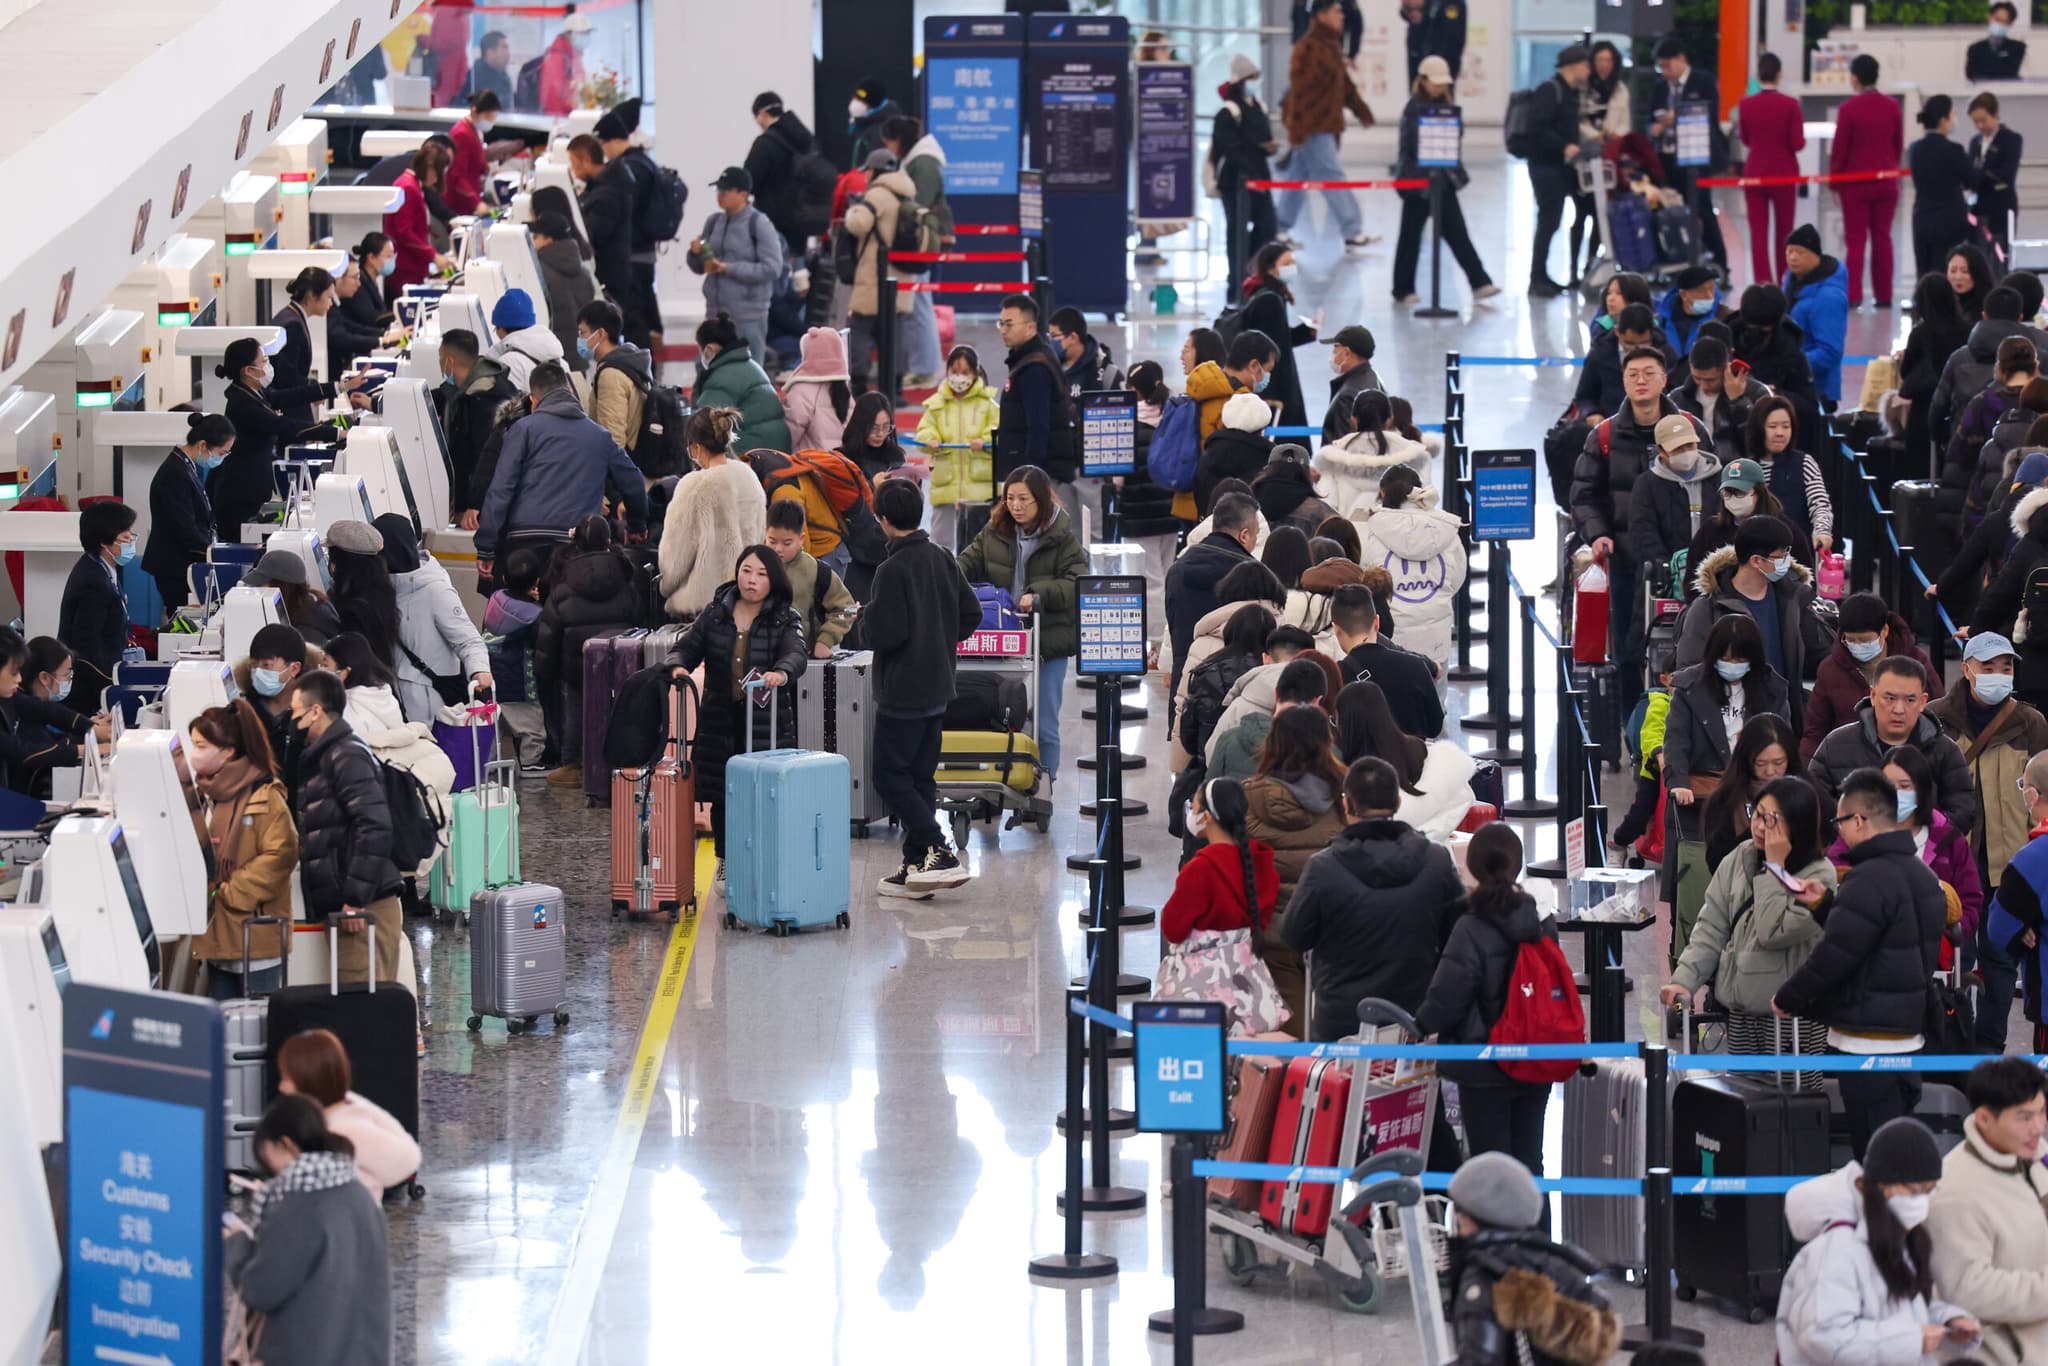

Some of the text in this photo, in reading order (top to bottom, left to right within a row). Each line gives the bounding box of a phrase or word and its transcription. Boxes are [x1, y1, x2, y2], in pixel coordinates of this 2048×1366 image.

[957, 634, 998, 652] 瑞斯
[1158, 1056, 1204, 1081] 出口
[1168, 1091, 1193, 1103] Exit
[1377, 1111, 1424, 1144] 爱依瑞斯
[120, 1151, 153, 1180] 海关
[103, 1180, 170, 1212] Customs
[80, 1237, 193, 1280] Security Check
[92, 1305, 180, 1341] Immigration
